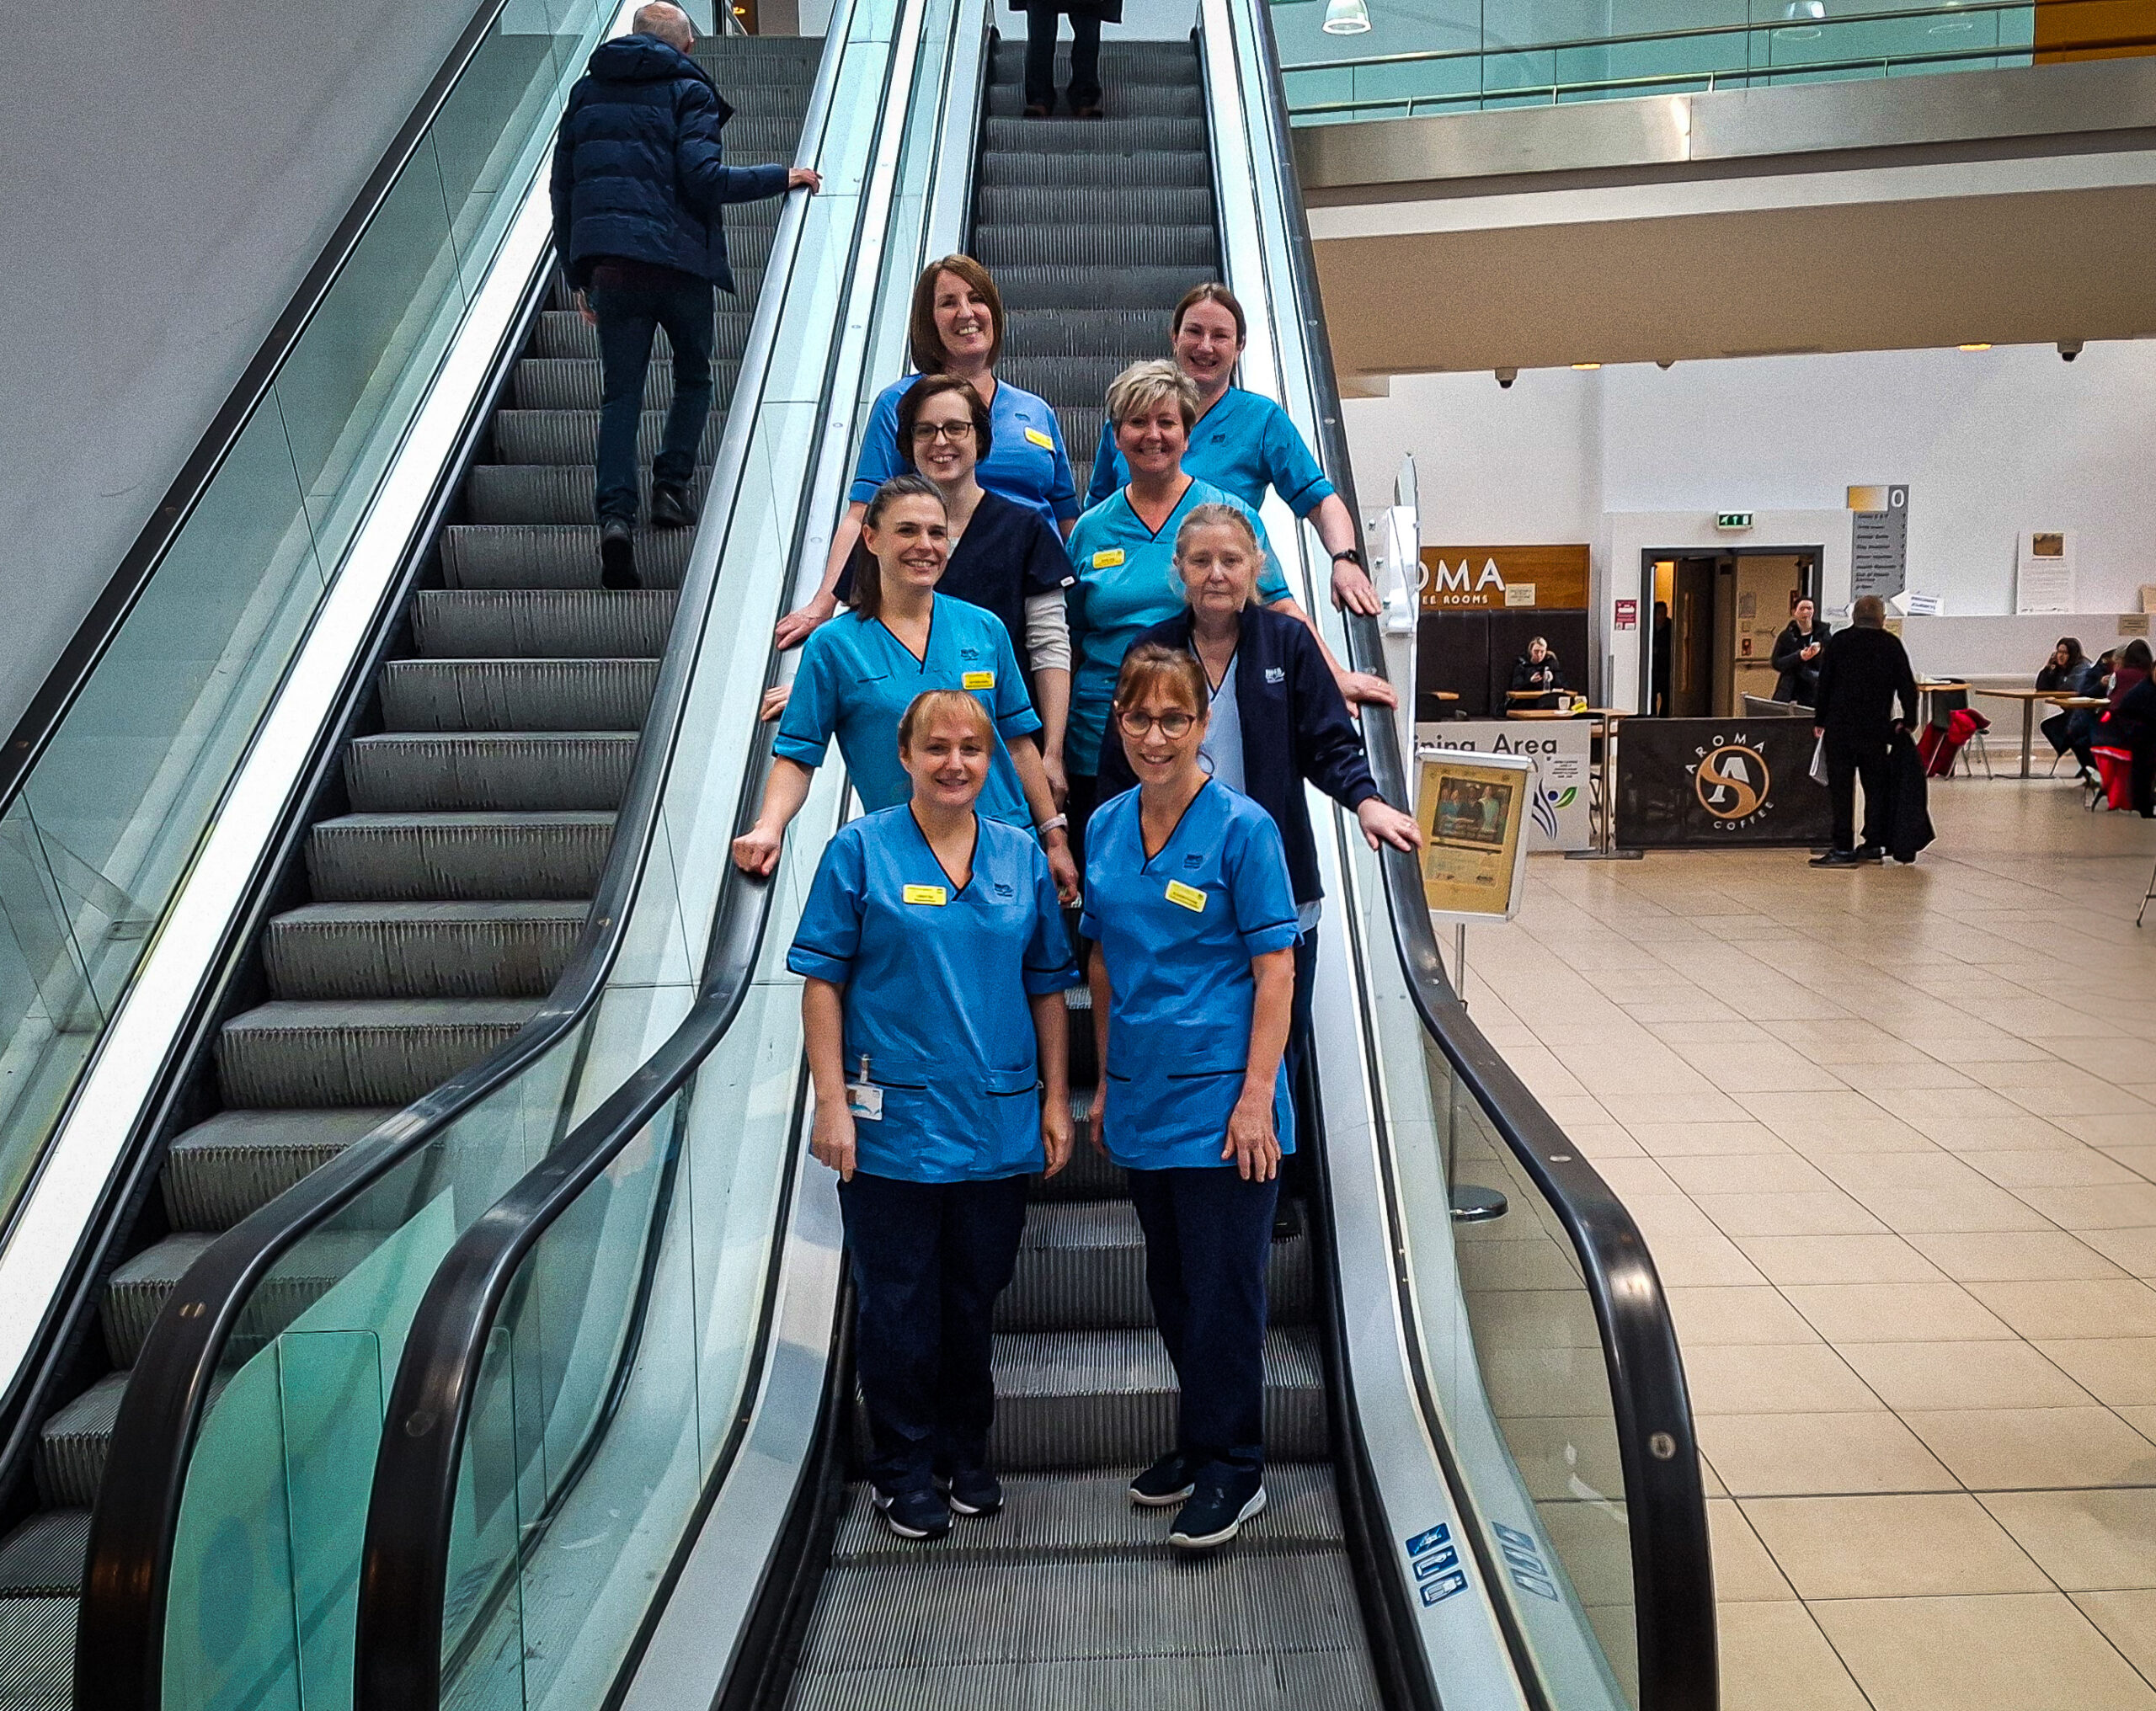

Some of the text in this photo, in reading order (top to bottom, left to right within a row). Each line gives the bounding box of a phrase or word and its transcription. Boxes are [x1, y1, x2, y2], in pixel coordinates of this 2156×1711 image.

[1444, 594, 1488, 605] ROOMS
[1492, 733, 1557, 754] Area
[1685, 733, 1765, 774] AROMA
[1713, 802, 1774, 830] COFFEE
